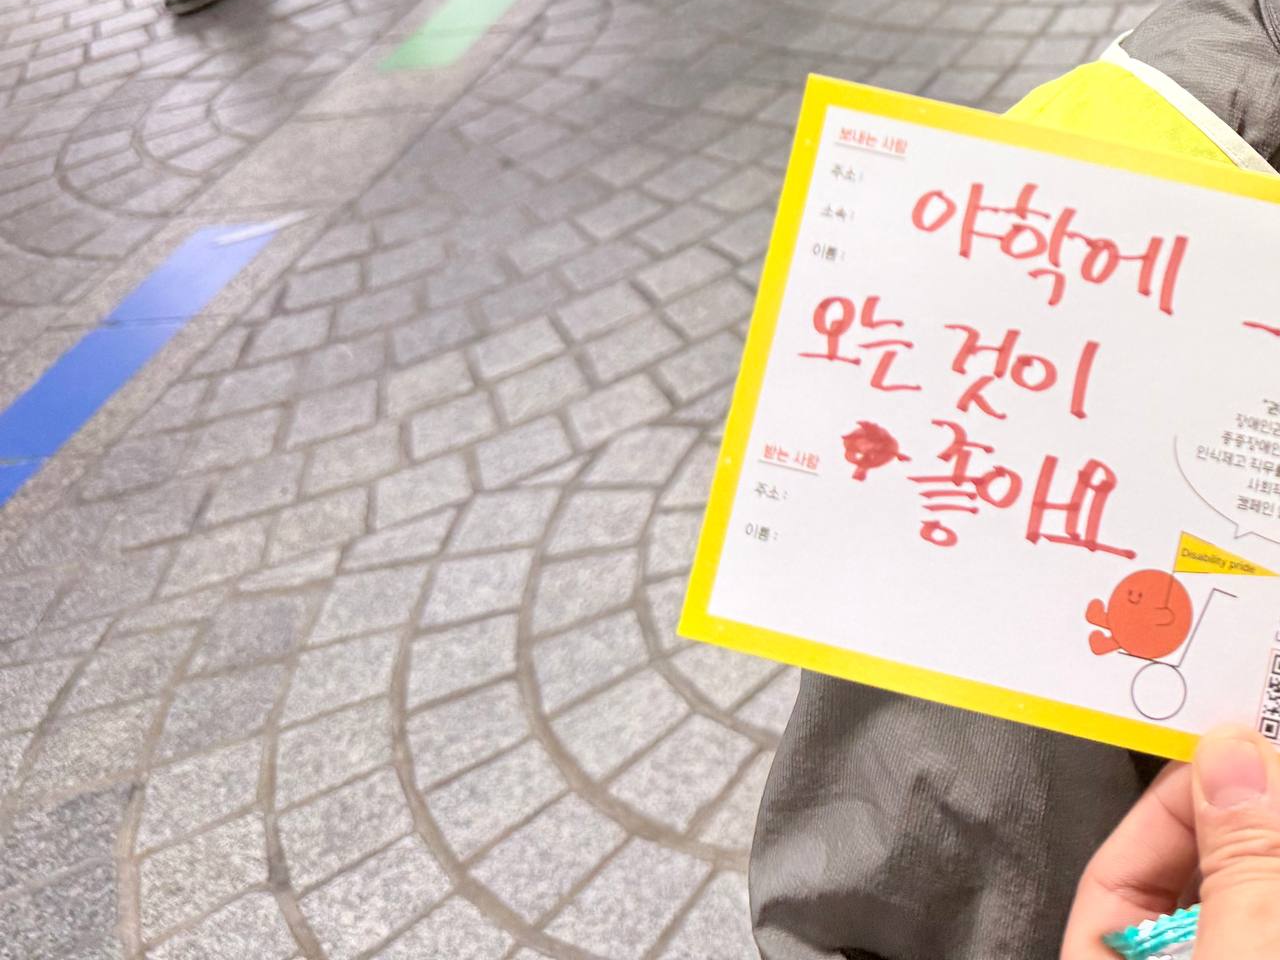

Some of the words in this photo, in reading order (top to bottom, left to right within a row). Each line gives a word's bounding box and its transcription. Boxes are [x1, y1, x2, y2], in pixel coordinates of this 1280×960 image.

[839, 127, 878, 147] 보내는
[882, 136, 909, 154] 사람
[912, 183, 1189, 315] 야학에
[798, 296, 922, 391] 오는
[944, 324, 1100, 420] 것이
[794, 450, 820, 470] 사람
[907, 419, 1136, 559] 좋아요
